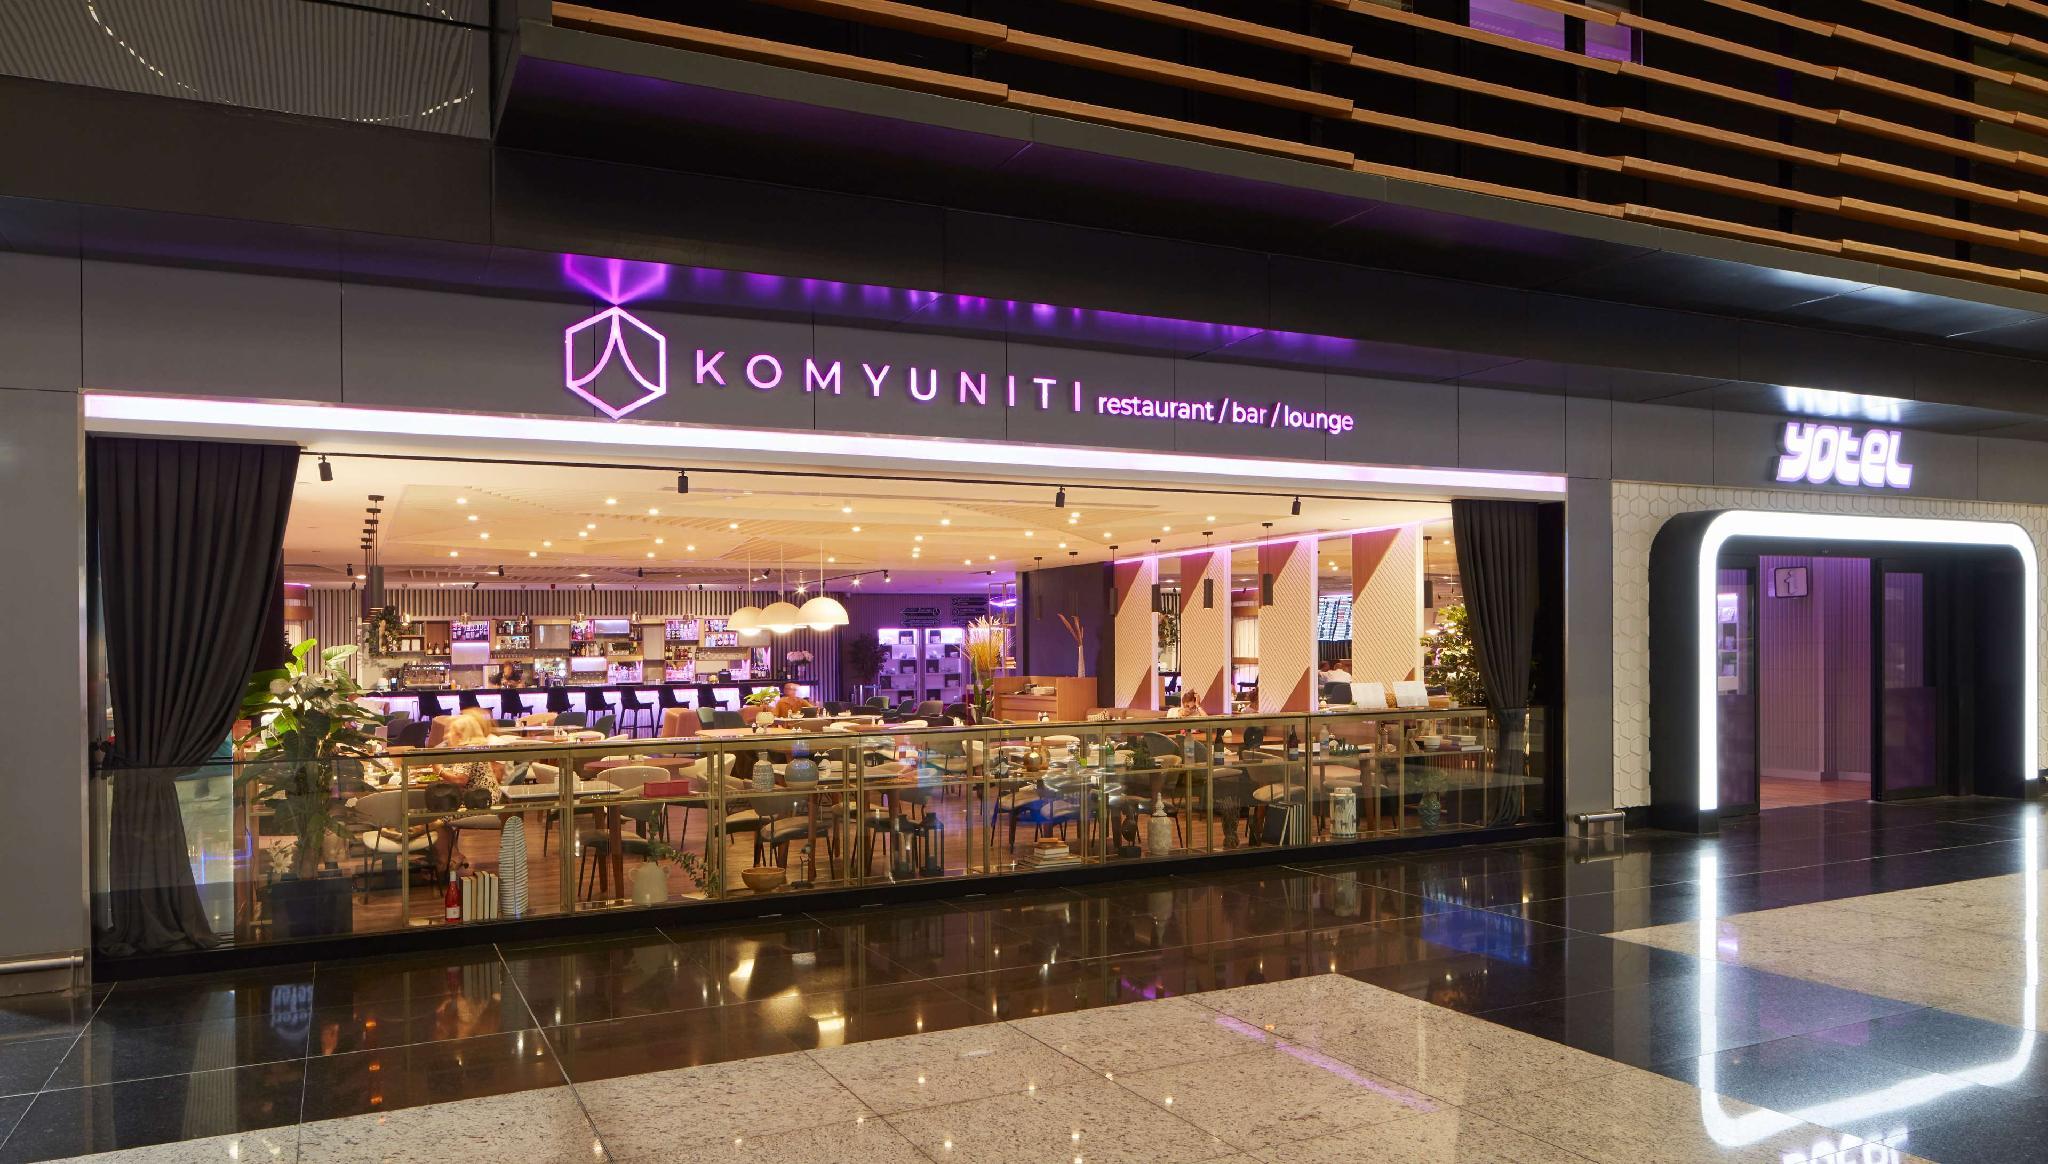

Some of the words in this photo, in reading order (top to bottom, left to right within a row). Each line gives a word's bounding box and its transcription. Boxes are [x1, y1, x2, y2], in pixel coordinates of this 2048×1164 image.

[695, 349, 1081, 412] KOMYUNITI
[1098, 396, 1215, 421] restaurant
[1232, 401, 1267, 424] bar
[1284, 405, 1354, 435] lounge
